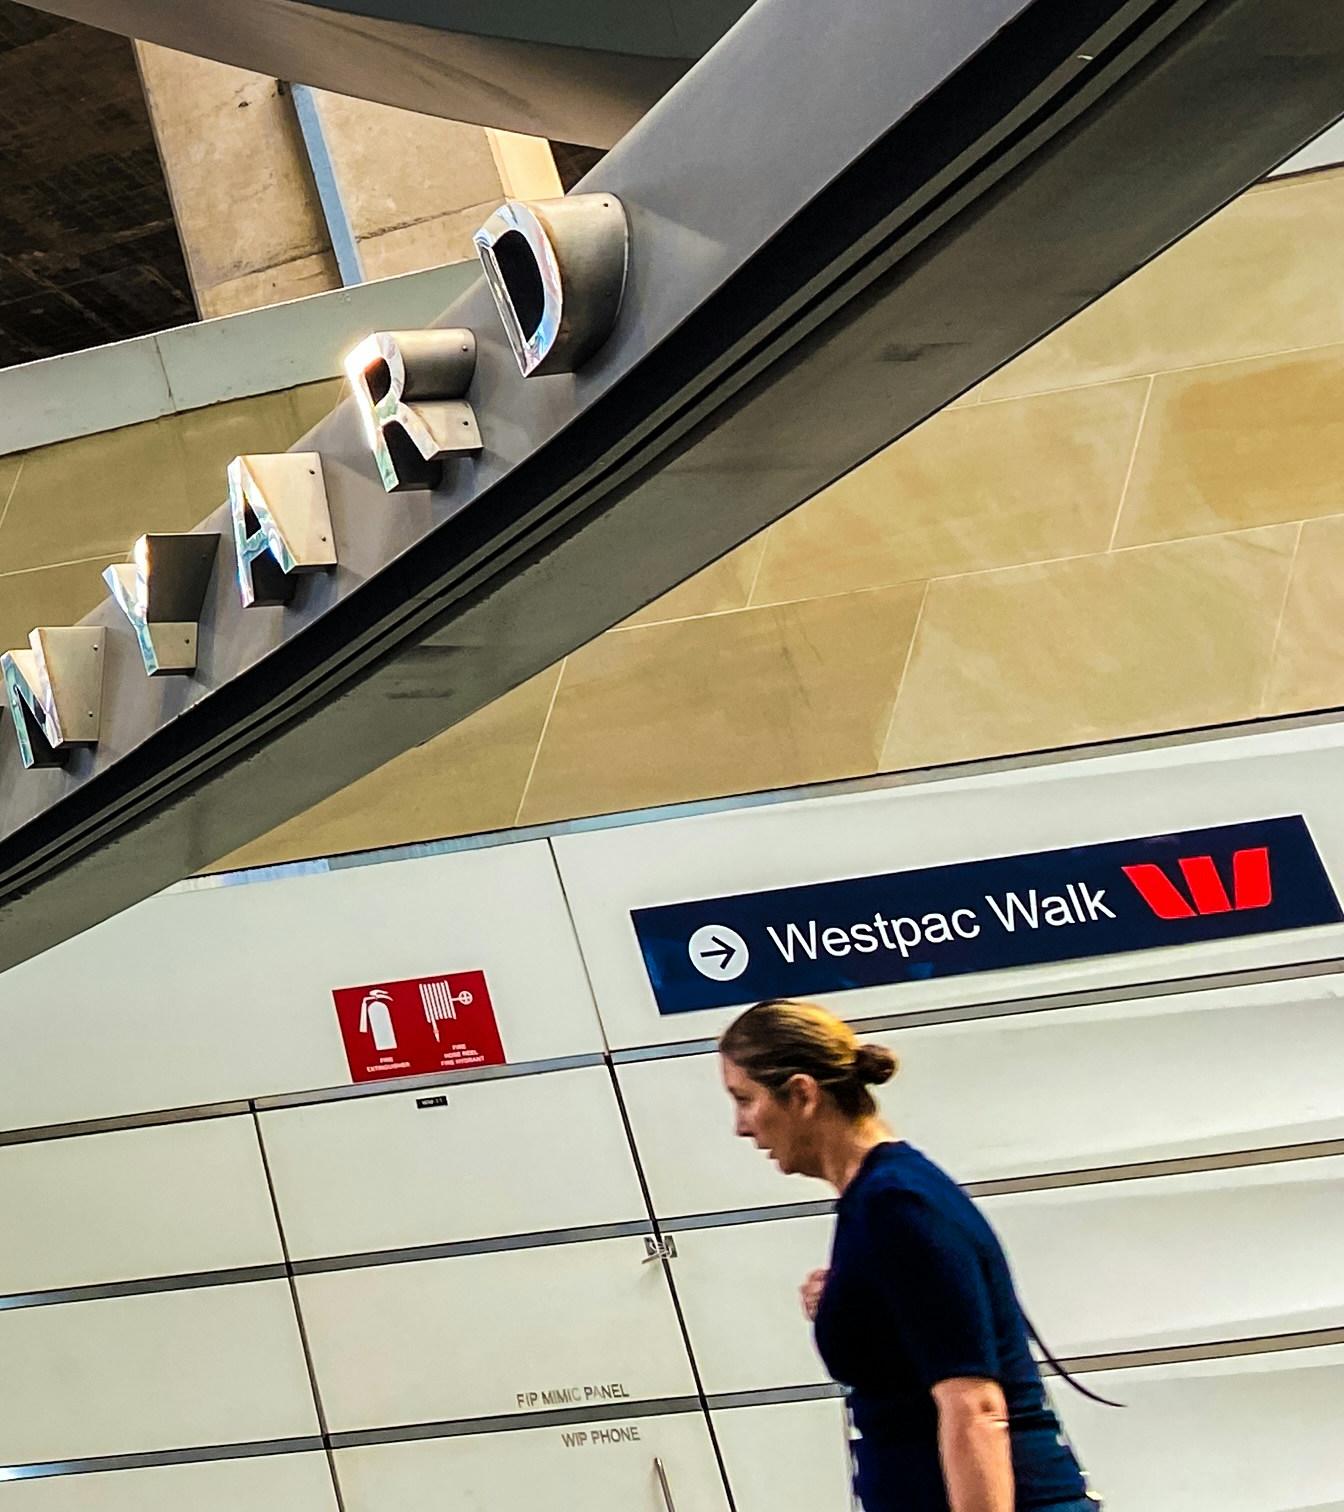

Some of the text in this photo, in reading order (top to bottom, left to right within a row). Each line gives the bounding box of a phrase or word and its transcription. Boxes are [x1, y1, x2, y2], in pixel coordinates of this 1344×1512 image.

[767, 882, 1116, 963] Westpac Walk
[516, 1384, 629, 1408] FIP MIMIC PANEL
[561, 1427, 641, 1447] WIP PHONE
